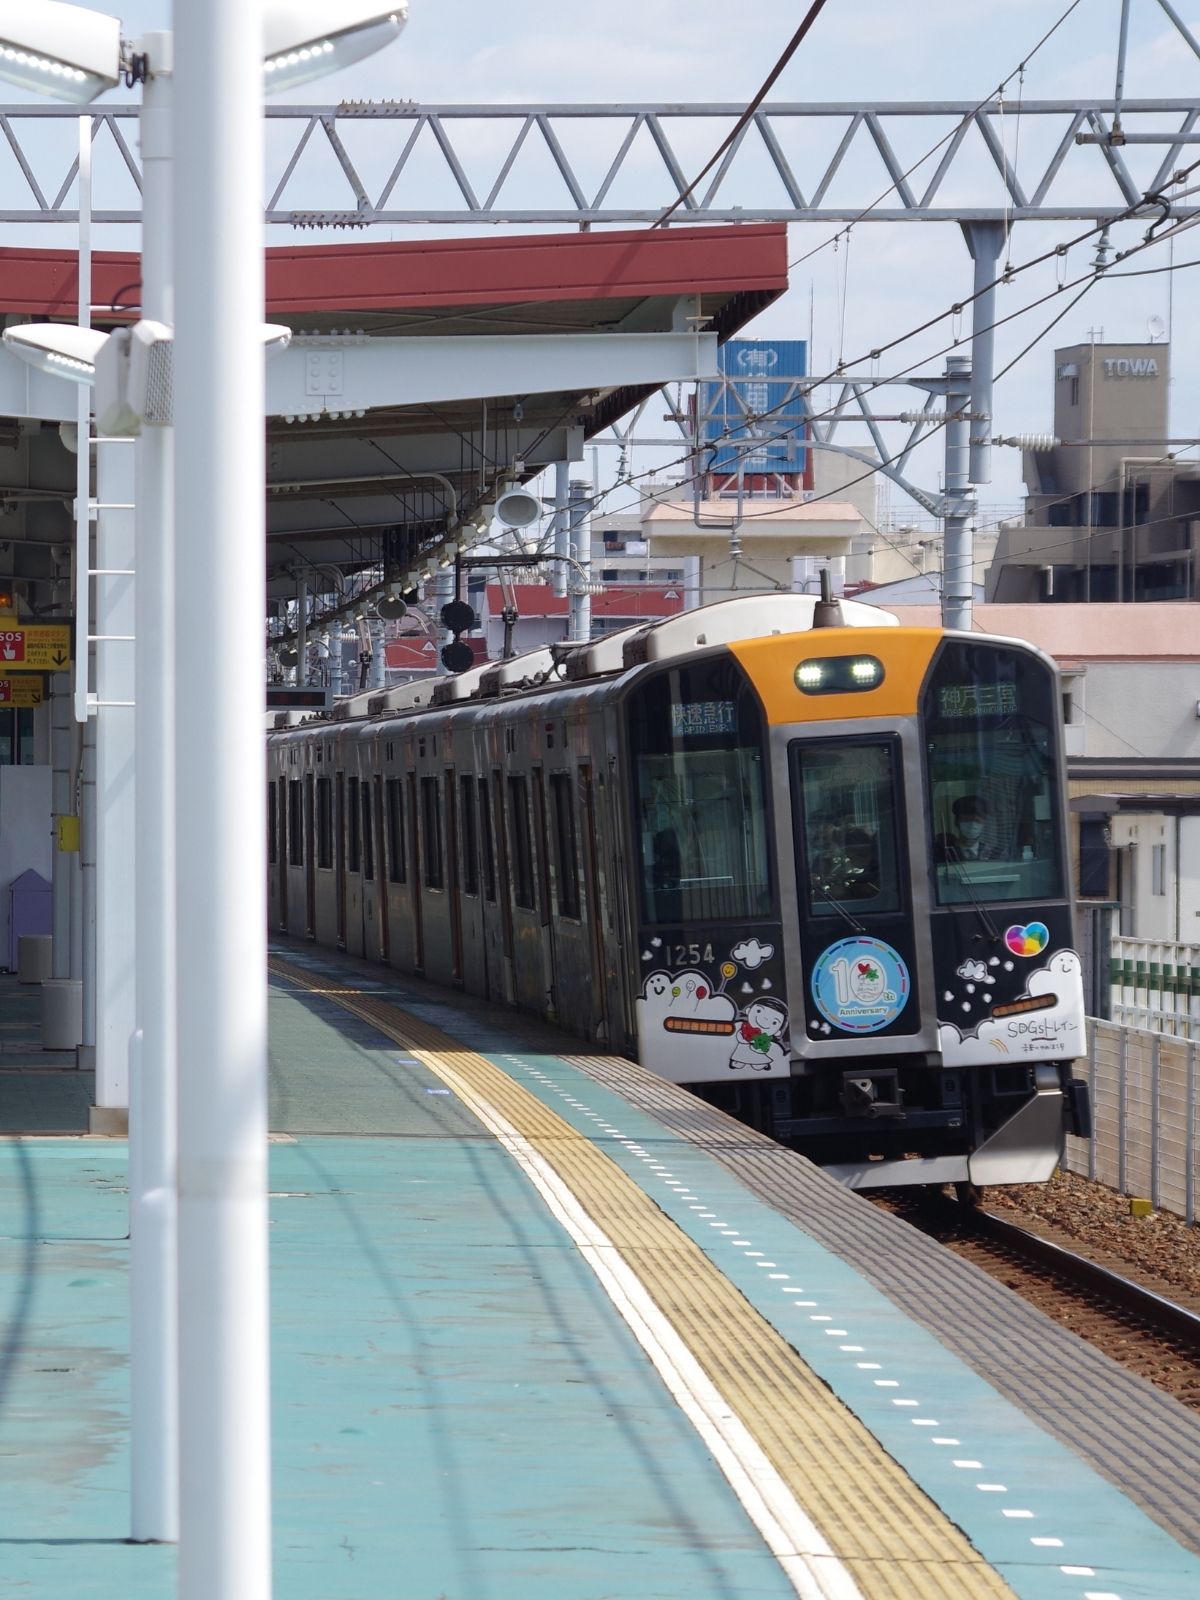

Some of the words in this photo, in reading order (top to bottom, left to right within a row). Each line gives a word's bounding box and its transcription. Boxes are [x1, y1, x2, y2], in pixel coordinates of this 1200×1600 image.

[1104, 358, 1159, 377] TOWA
[672, 701, 734, 726] 快速急行
[666, 943, 716, 966] 1254
[840, 1007, 887, 1017] Anniversary
